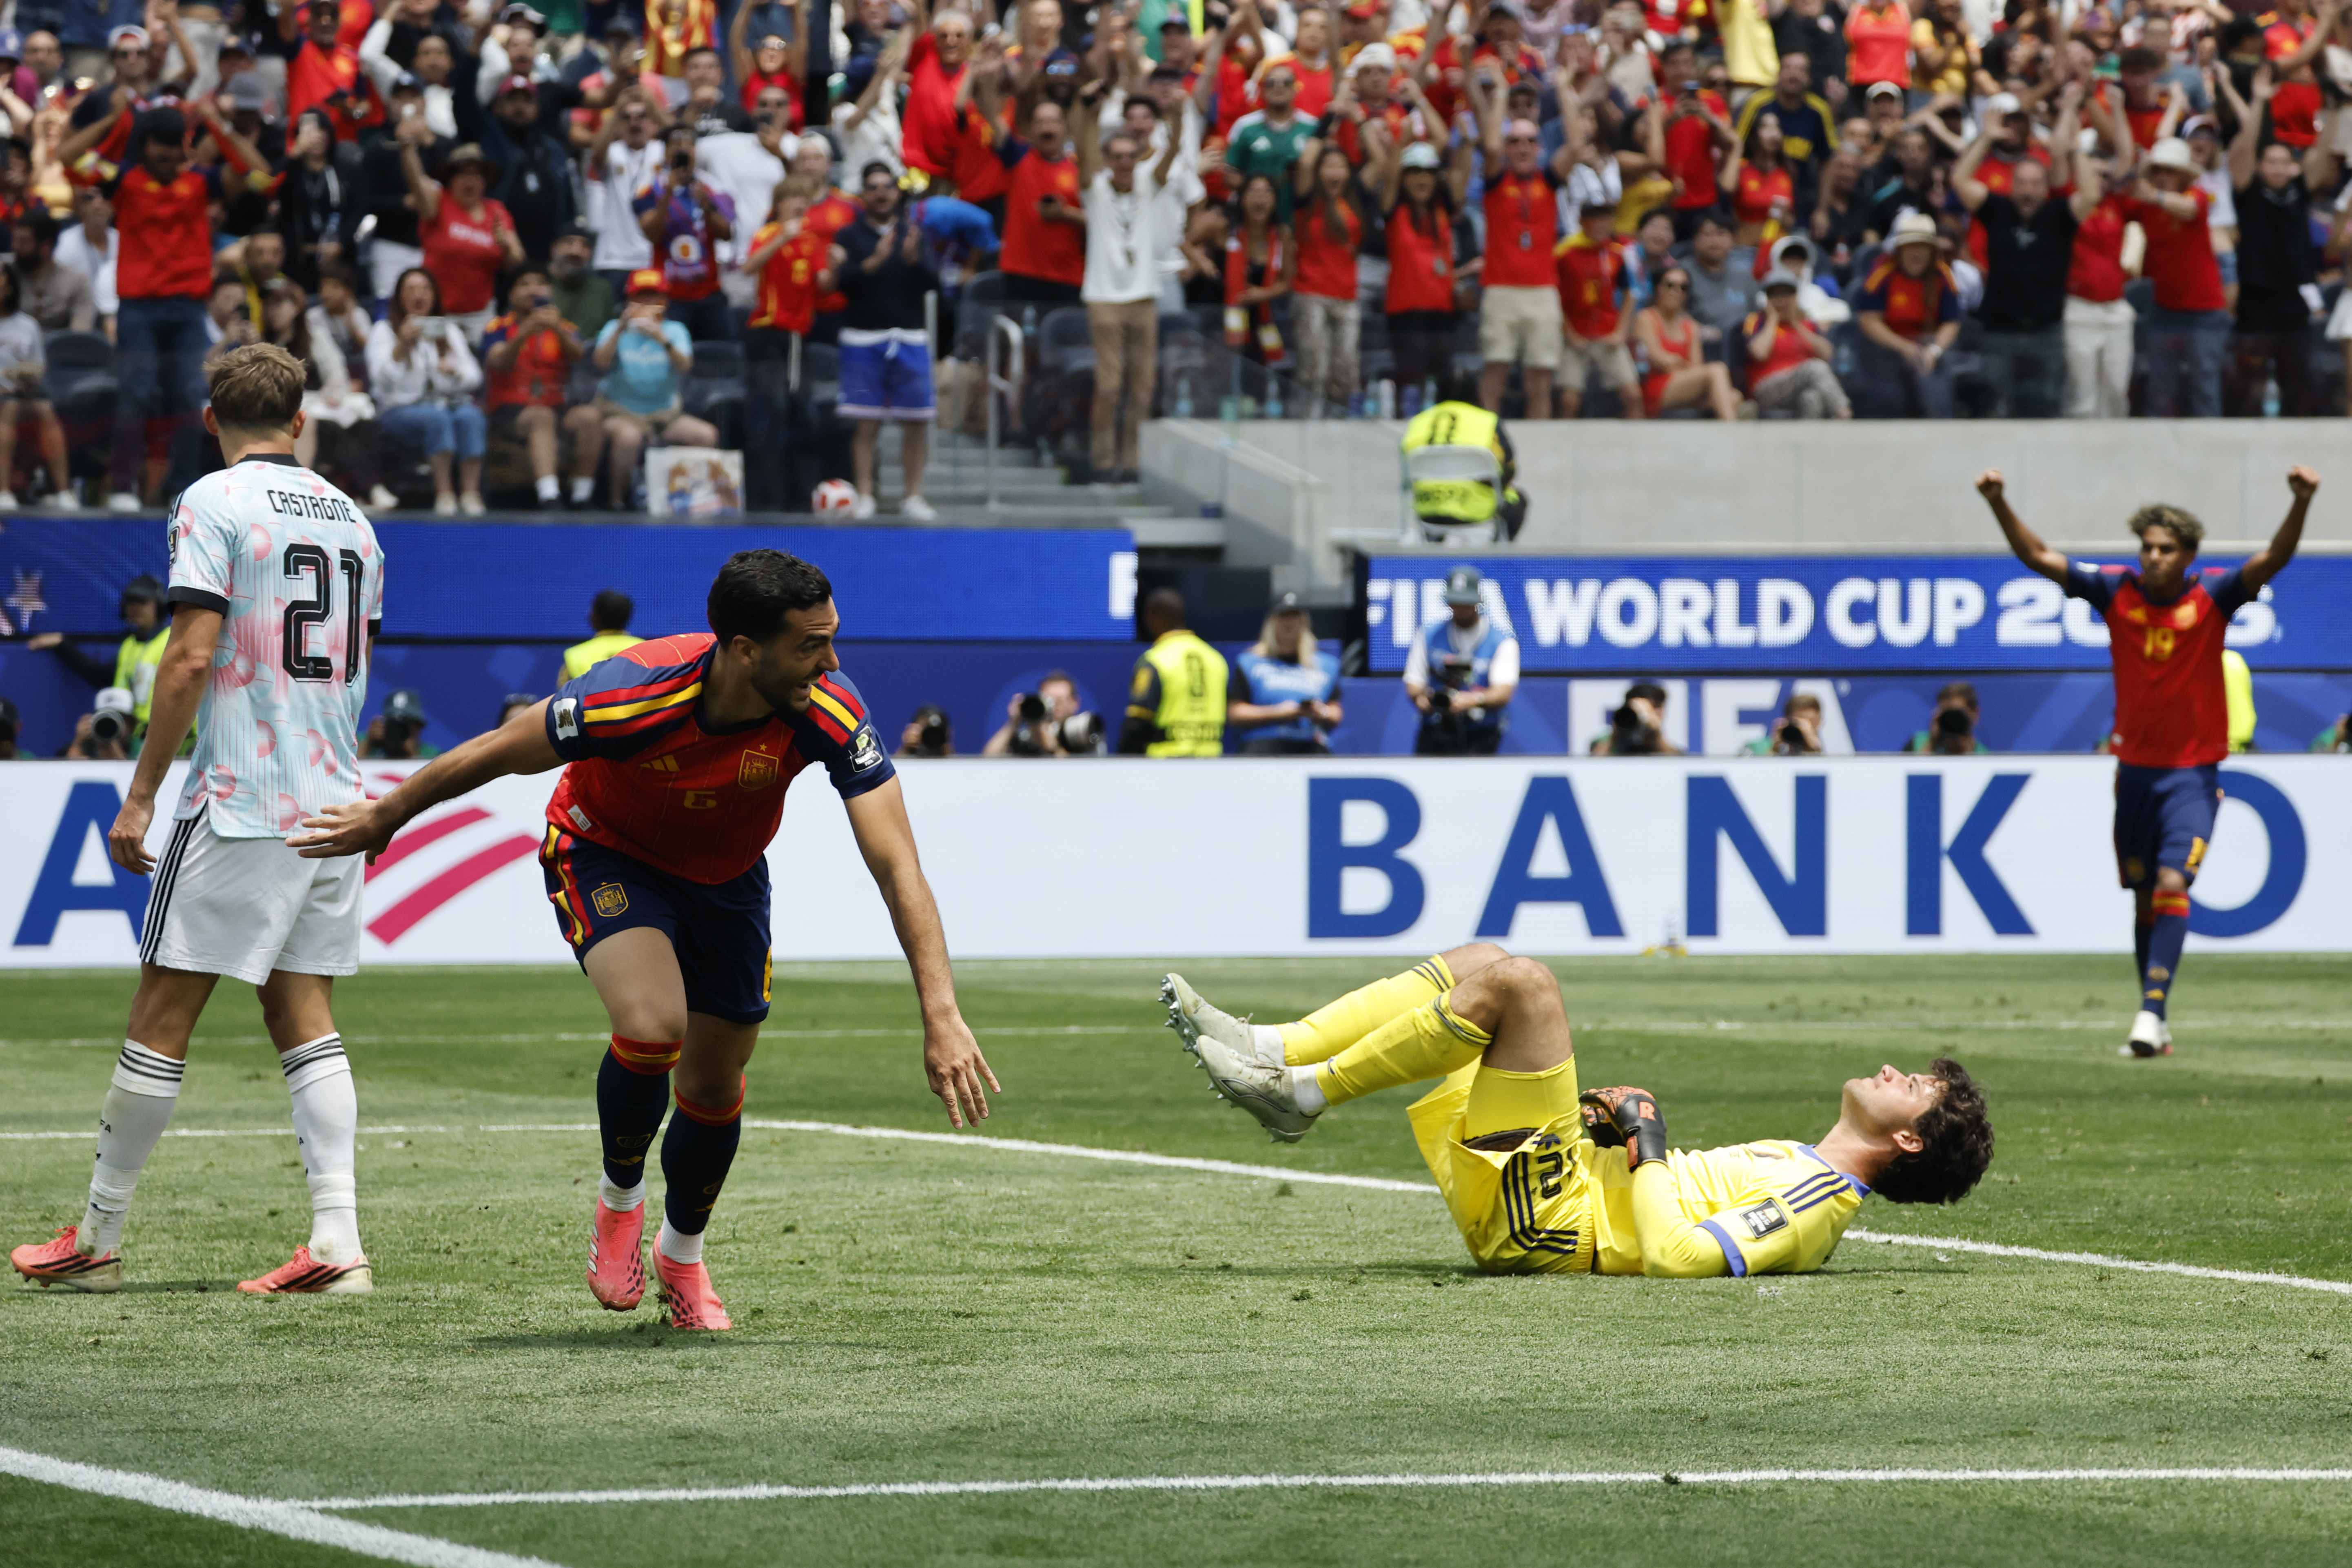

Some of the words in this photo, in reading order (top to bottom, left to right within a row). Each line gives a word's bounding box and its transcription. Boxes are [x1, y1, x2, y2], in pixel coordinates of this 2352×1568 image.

[267, 490, 356, 523] CASTAGNE
[283, 543, 366, 687] 21
[1524, 577, 1815, 648] WORLD
[1824, 577, 1986, 648] CUP
[2144, 627, 2175, 661] 19
[684, 791, 717, 809] 6
[1306, 773, 2036, 939] BANK
[1639, 1101, 1656, 1121] R
